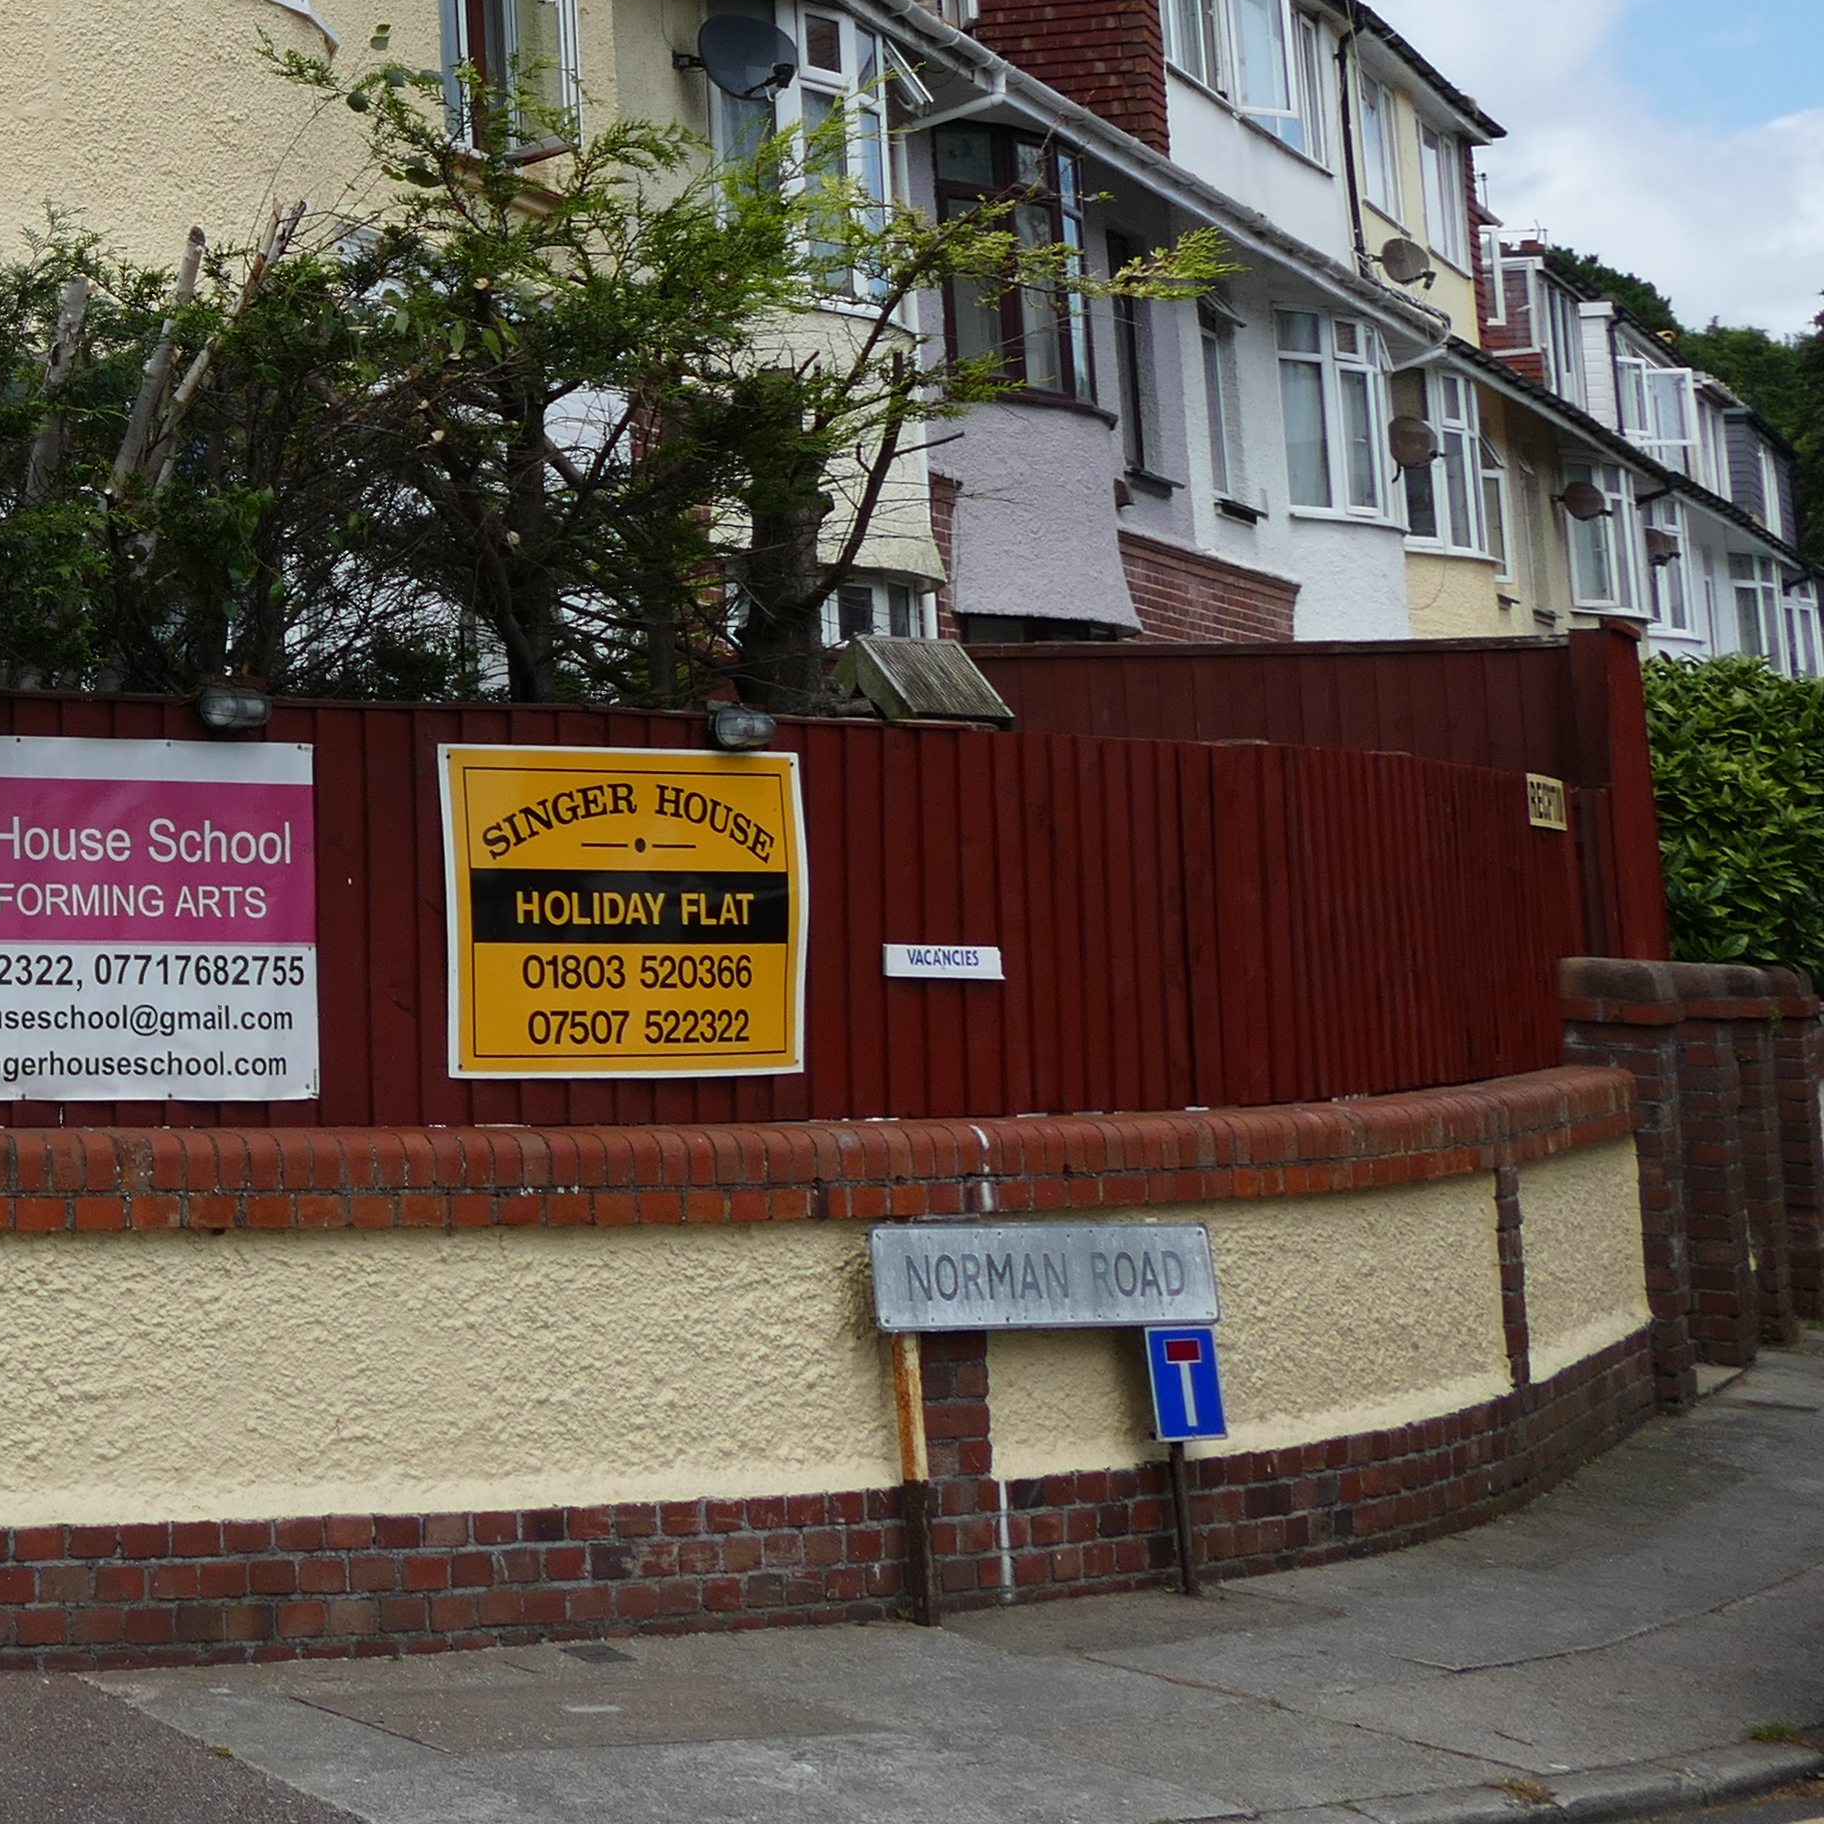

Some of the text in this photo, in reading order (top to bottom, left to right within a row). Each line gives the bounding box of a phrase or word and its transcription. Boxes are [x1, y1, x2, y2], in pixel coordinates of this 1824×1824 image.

[482, 782, 775, 864] SINGER HOUSE
[147, 818, 292, 865] School
[174, 886, 268, 919] ARTS
[516, 890, 755, 926] HOLIDAY FLAT
[93, 954, 305, 987] 07717682755
[522, 954, 753, 989] 01803 520366
[906, 949, 979, 966] VACANCIES
[527, 1009, 750, 1045] 07507 522322
[905, 1250, 1186, 1302] NORMAN ROAD
